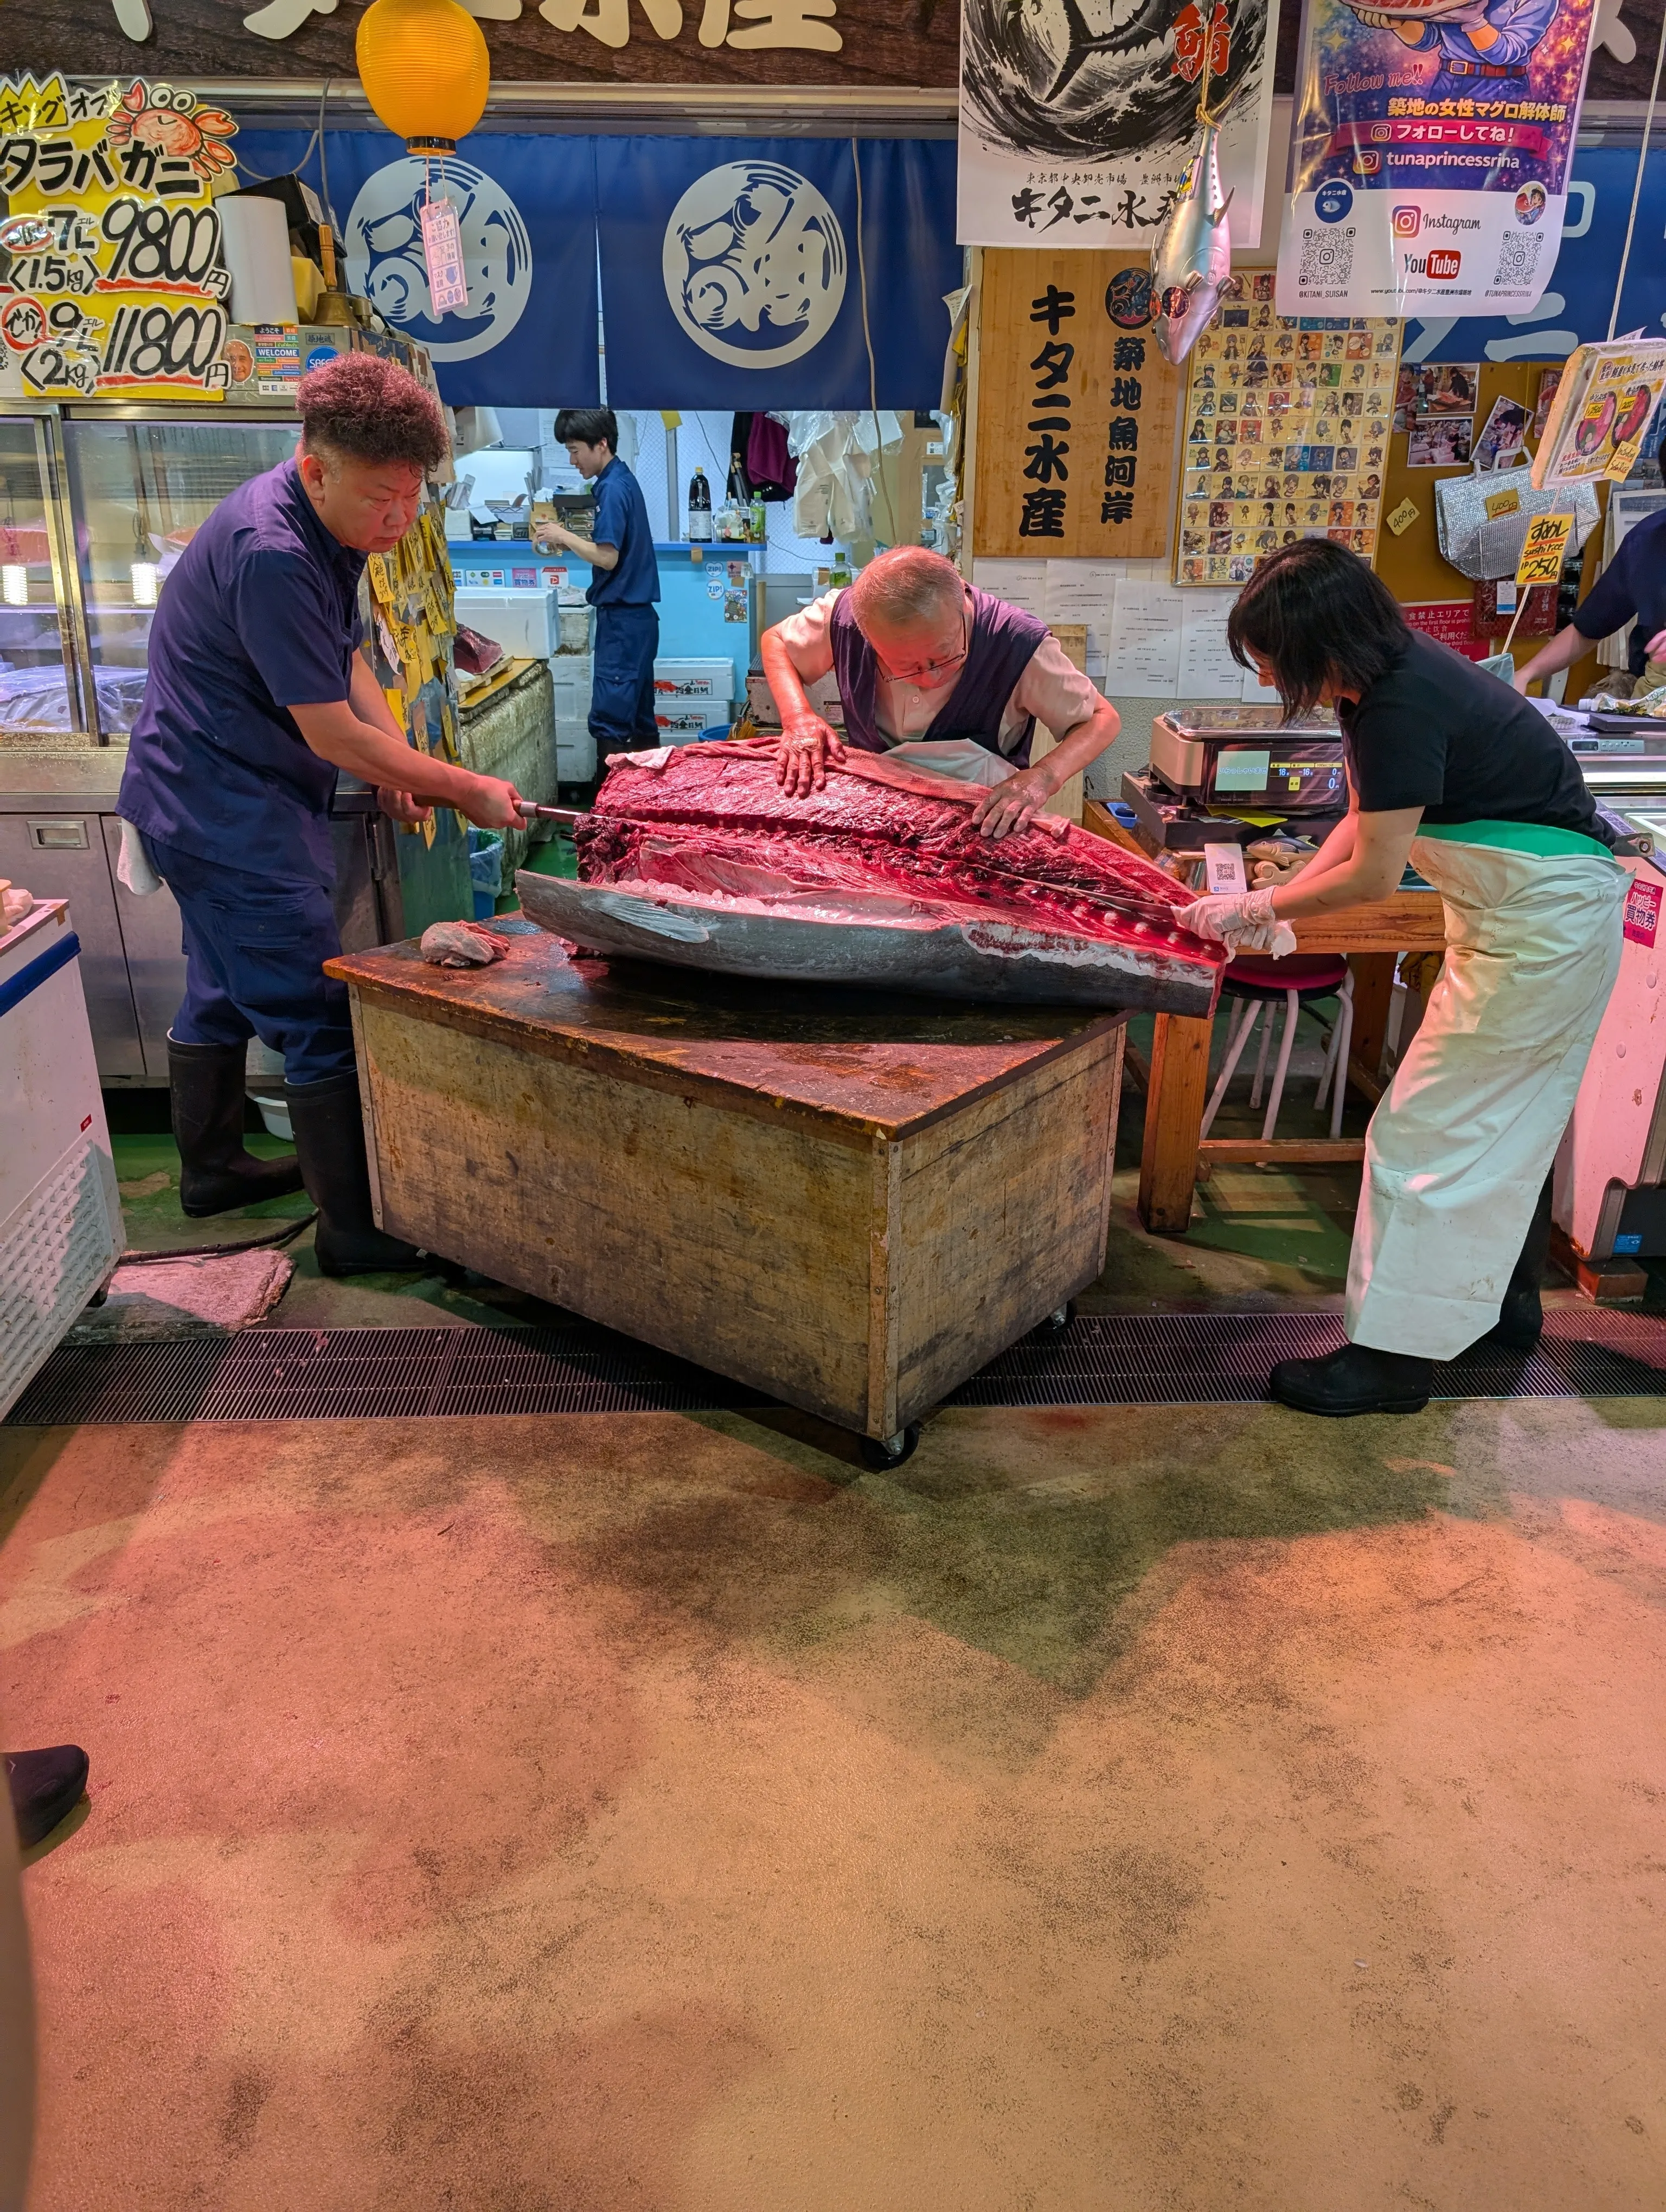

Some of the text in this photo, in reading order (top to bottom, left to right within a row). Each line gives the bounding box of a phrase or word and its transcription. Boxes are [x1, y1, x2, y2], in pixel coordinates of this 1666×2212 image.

[1324, 72, 1384, 95] Follow
[0, 95, 66, 128] キング
[1387, 98, 1567, 122] 築地の女性マグロ解体師
[1396, 124, 1514, 142] フォローしてね!
[0, 138, 201, 196] タラバガニ
[1386, 151, 1520, 169] tunaprincessrina
[1422, 213, 1482, 235] Instagram
[101, 197, 228, 297] 9800円
[1404, 253, 1459, 275] YouTube
[1299, 291, 1348, 299] @KITANI_SUISAN
[103, 307, 231, 389] 11800円
[258, 349, 298, 357] WELCOME
[1019, 284, 1076, 538] キタニ水産
[1393, 507, 1415, 529] 400円
[1523, 544, 1547, 558] sushi
[1525, 555, 1559, 580] 250円
[1218, 766, 1267, 775] いらっしゃいませ
[1630, 891, 1657, 909] ハッピー
[1625, 903, 1656, 931] 買物券
